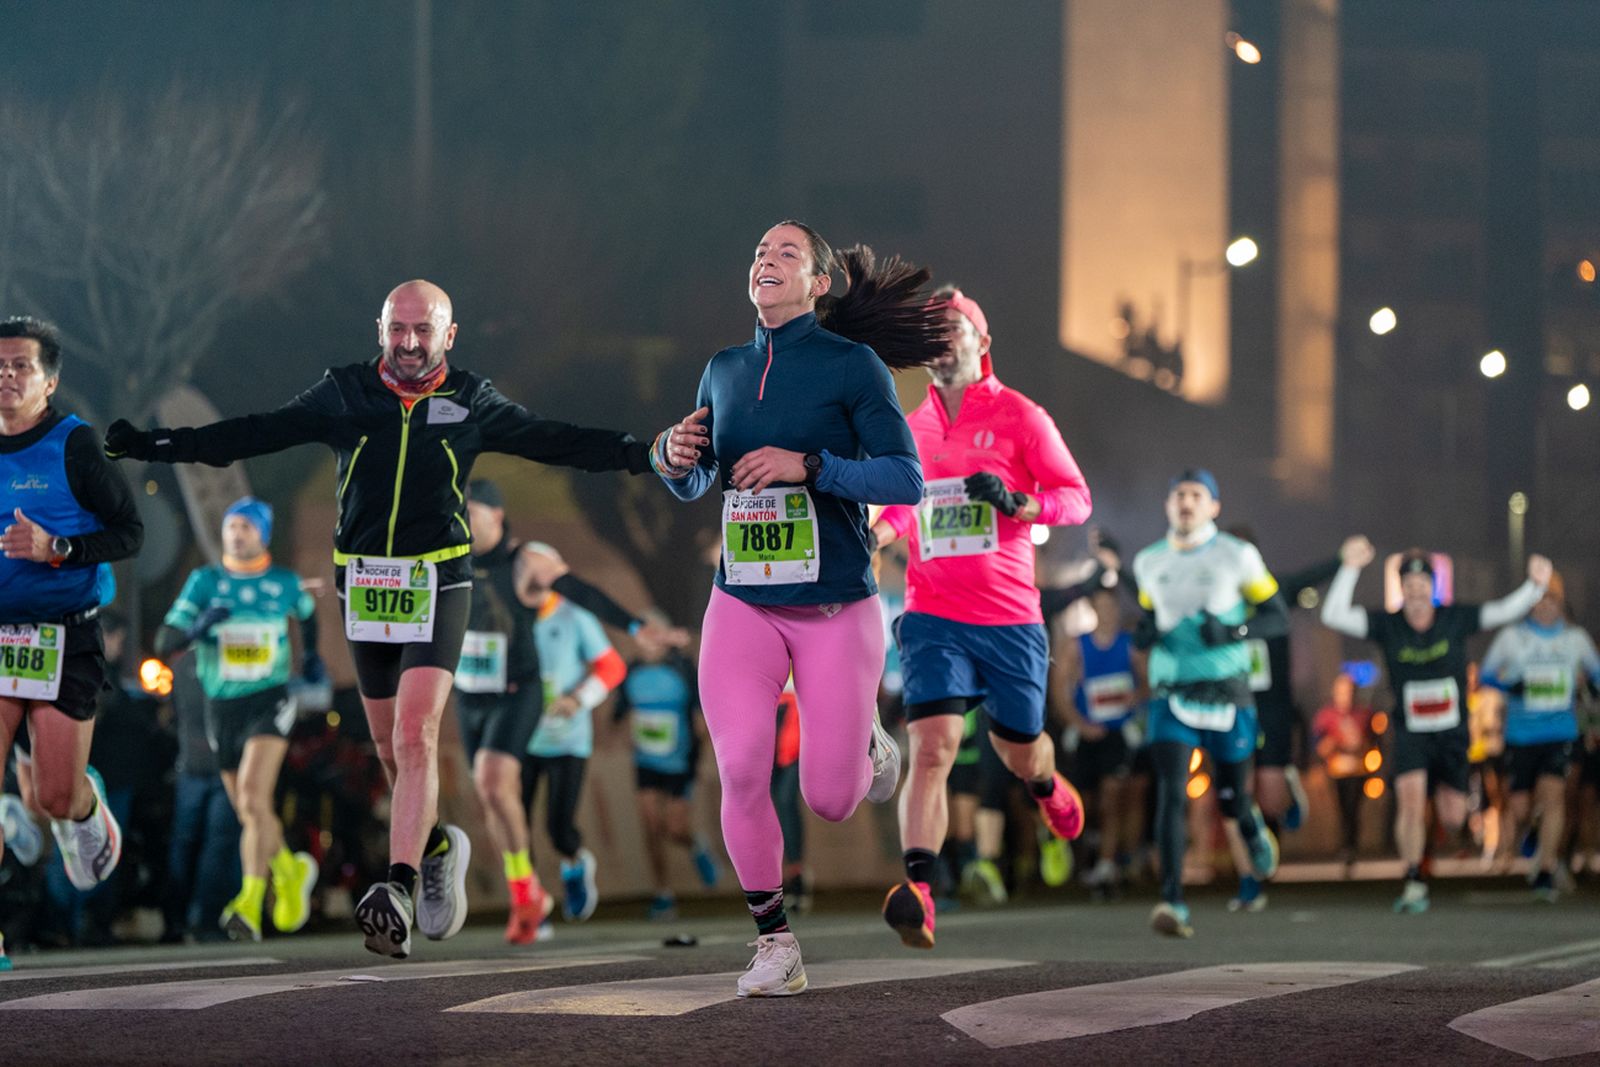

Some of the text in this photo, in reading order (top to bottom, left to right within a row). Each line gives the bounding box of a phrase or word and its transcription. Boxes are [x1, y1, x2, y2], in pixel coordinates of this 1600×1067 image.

[765, 499, 776, 508] DE
[731, 511, 745, 521] SAN
[931, 505, 983, 530] 2267
[739, 522, 795, 552] 7887
[364, 568, 401, 577] NOCHE DE
[355, 577, 371, 586] SAN
[365, 588, 415, 615] 9176
